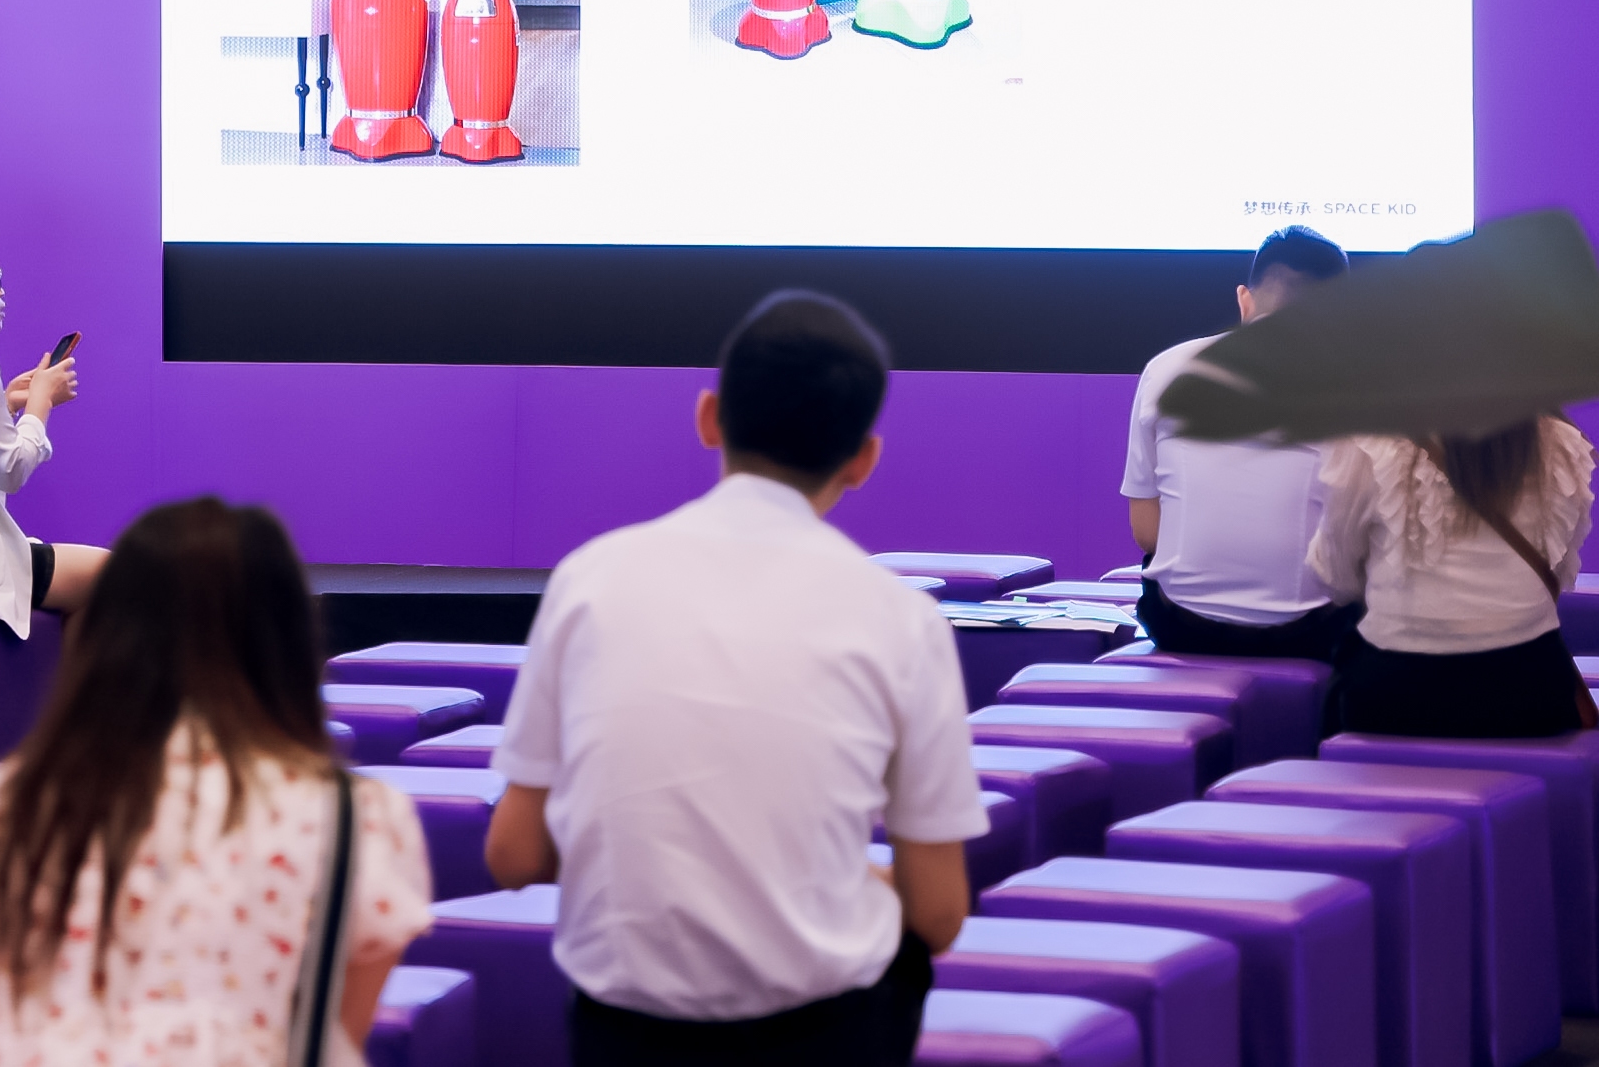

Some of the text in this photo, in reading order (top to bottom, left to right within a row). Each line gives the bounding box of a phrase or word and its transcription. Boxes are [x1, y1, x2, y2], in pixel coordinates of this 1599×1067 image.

[1243, 201, 1310, 215] 梦想传承
[1323, 203, 1381, 215] SPACE
[1388, 203, 1417, 215] KID
